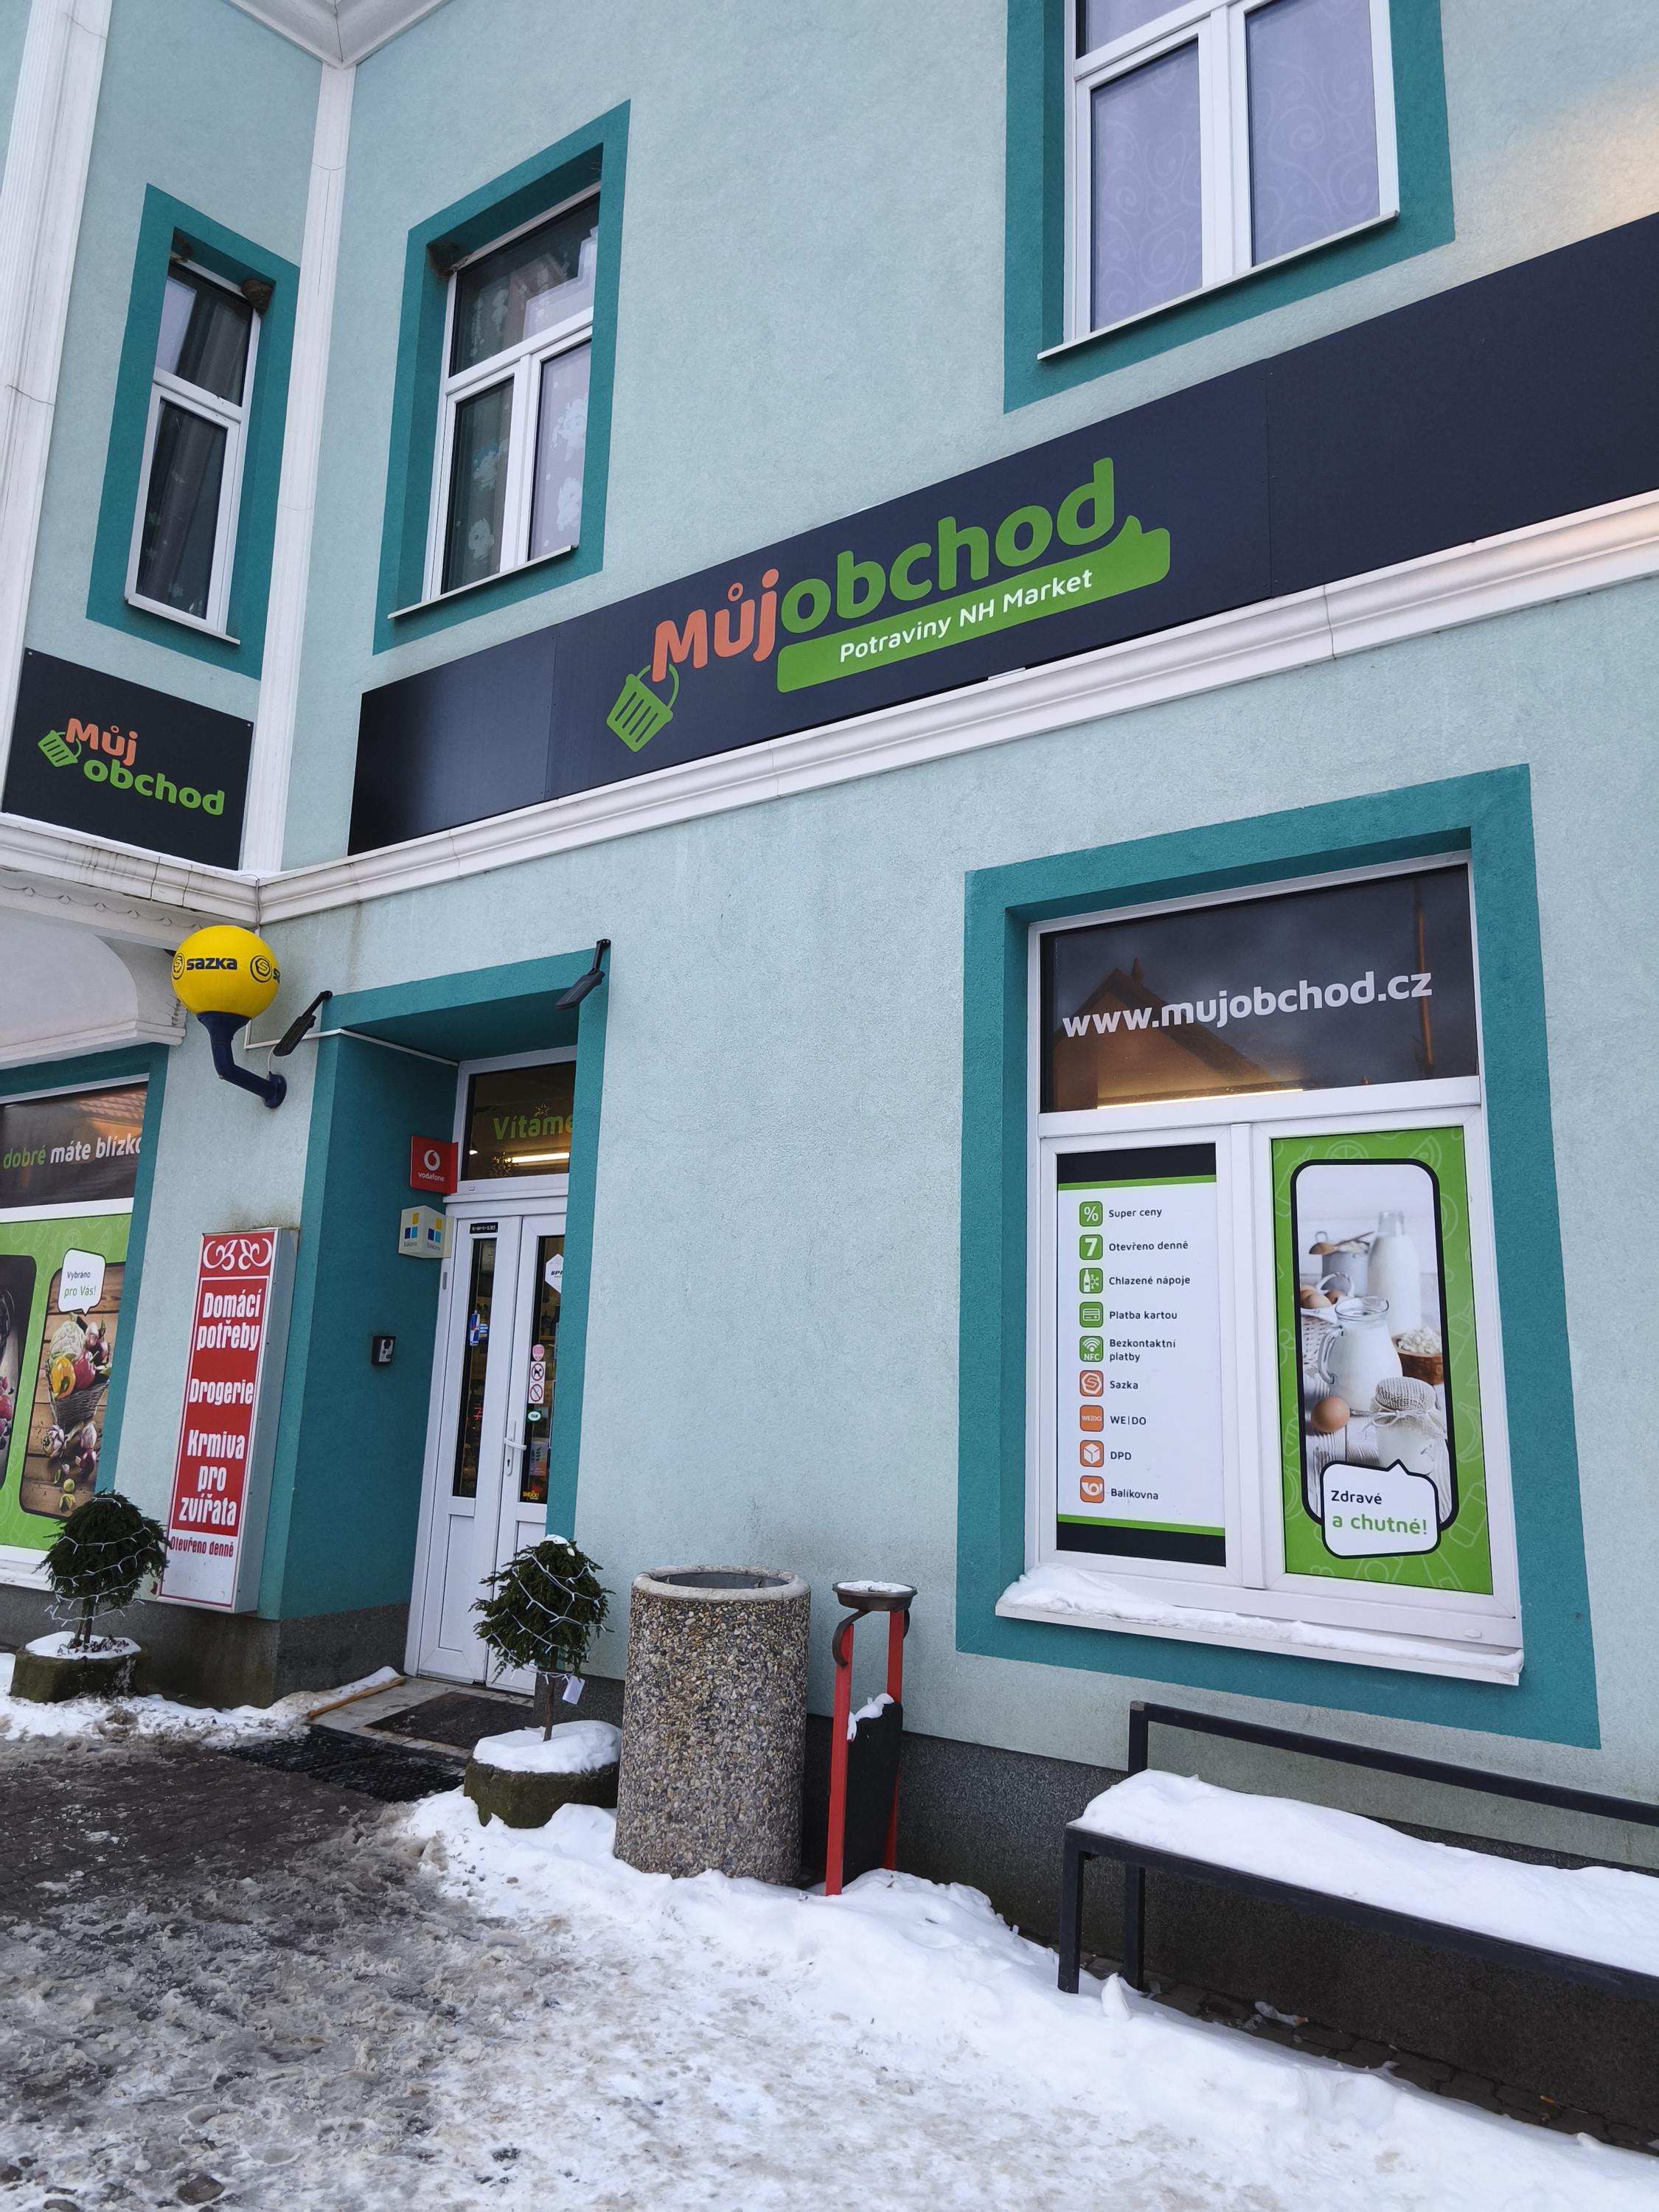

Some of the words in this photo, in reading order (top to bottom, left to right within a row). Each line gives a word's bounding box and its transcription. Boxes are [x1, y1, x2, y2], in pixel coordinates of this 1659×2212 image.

[839, 617, 952, 664] Potraviny
[959, 598, 995, 627] NH
[1002, 568, 1093, 616] Market
[66, 718, 139, 766] Můj
[83, 759, 225, 815] obchod
[1062, 971, 1433, 1037] www.mujobchod.cz
[3, 1145, 46, 1169] dobré
[50, 1141, 91, 1164] máte
[418, 1172, 445, 1182] vodafone
[1109, 1209, 1137, 1219] Super
[1139, 1208, 1162, 1217] ceny
[1085, 1238, 1098, 1256] 7
[1109, 1242, 1155, 1251] Otevřeno
[1158, 1240, 1189, 1250] denně
[1109, 1276, 1153, 1285] Chlazené
[1156, 1276, 1191, 1286] nápoje
[64, 1288, 77, 1299] pro
[203, 1289, 262, 1318] Domácí
[1109, 1311, 1141, 1320] Platba
[1144, 1311, 1178, 1320] kartou
[196, 1320, 260, 1352] potřeby
[1109, 1339, 1176, 1349] Bezkontaktní
[1084, 1353, 1100, 1361] NFC
[1109, 1352, 1141, 1363] platby
[189, 1378, 254, 1405] Drogerie
[1110, 1380, 1138, 1389] Sazka
[187, 1429, 246, 1459] Krmiva
[1110, 1451, 1132, 1460] DPD
[197, 1465, 227, 1492] pro
[1110, 1488, 1158, 1500] Balíkovna
[1331, 1490, 1382, 1504] Zdravé
[179, 1493, 237, 1526] zvířata
[1332, 1516, 1343, 1527] a
[1351, 1514, 1427, 1534] chutné!
[170, 1536, 206, 1554] Otevřeno
[209, 1541, 234, 1557] denně
